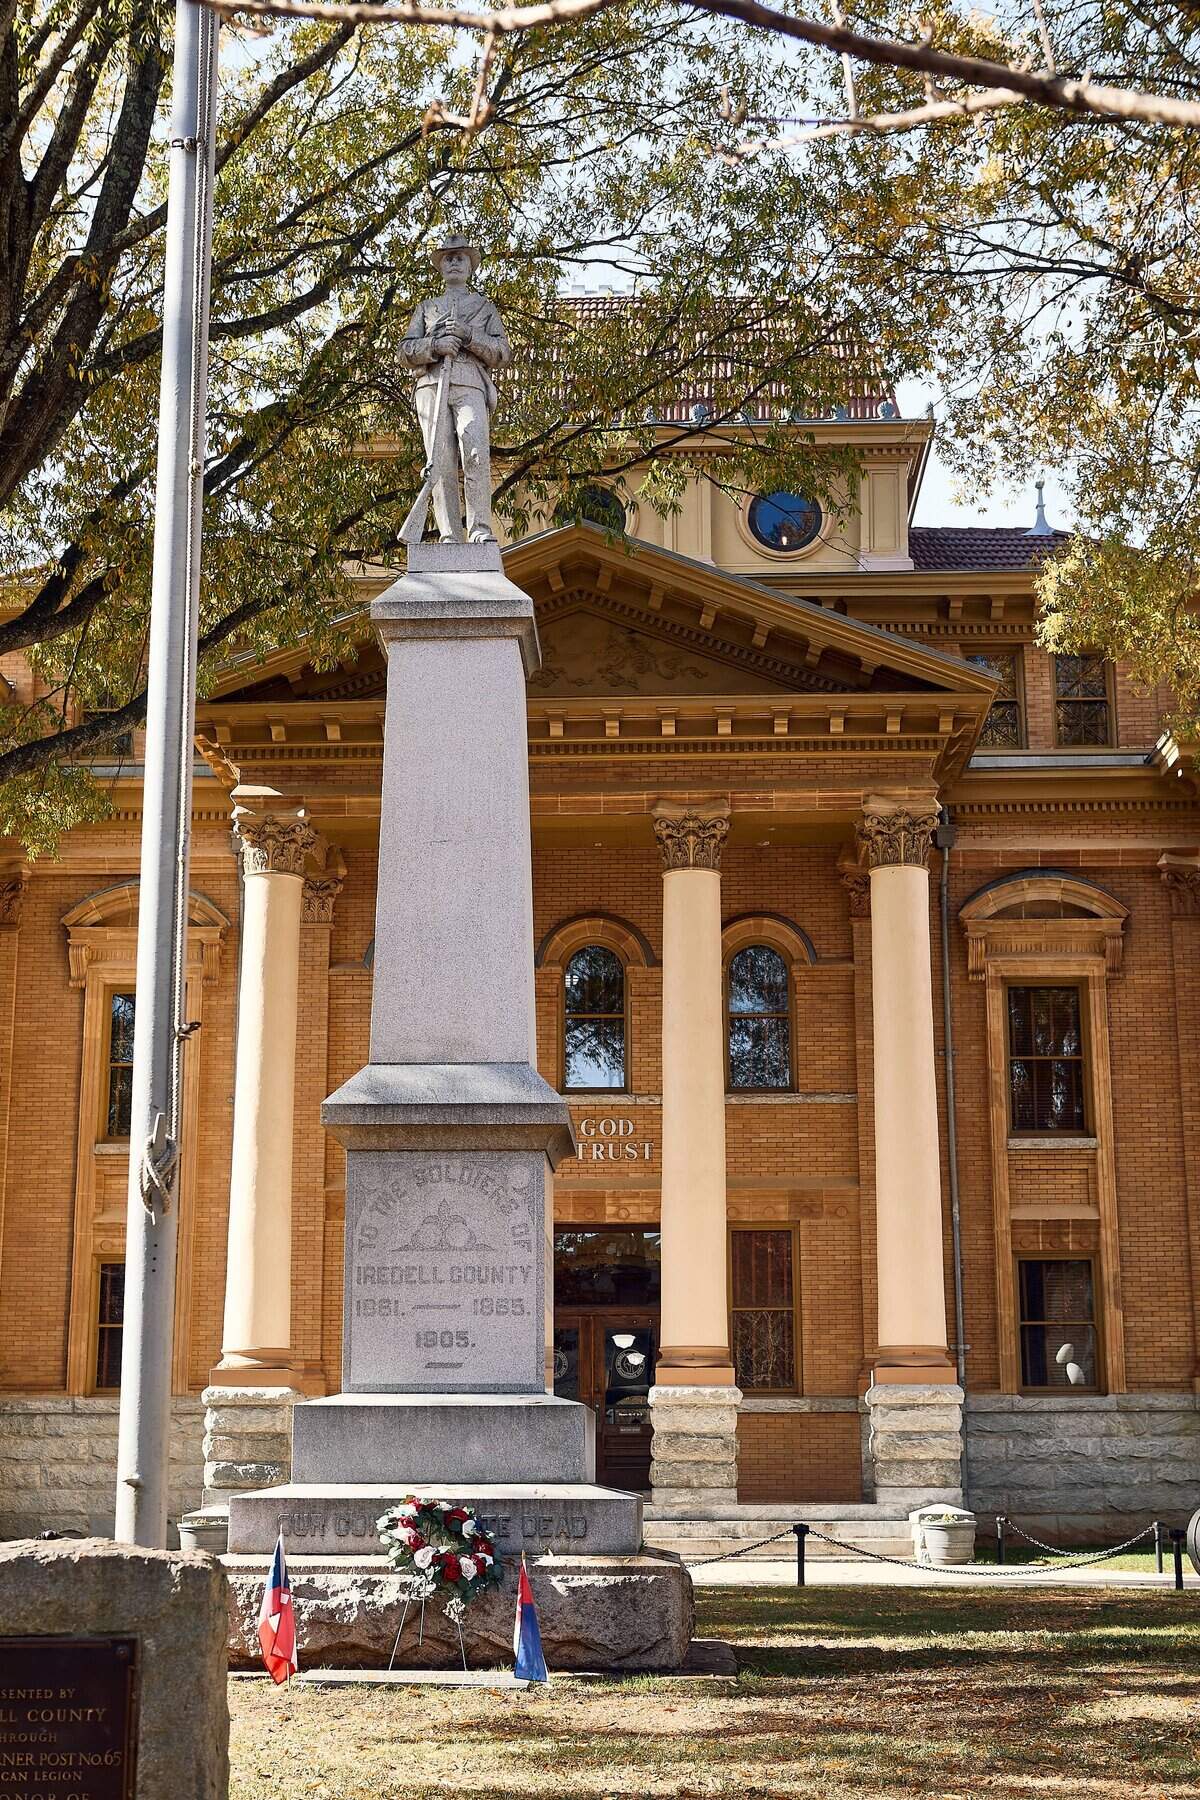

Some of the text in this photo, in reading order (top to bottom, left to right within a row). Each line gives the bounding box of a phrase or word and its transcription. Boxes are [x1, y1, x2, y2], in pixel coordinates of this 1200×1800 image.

[580, 1118, 634, 1137] GOD
[576, 1142, 654, 1161] TRUST
[358, 1164, 533, 1253] TO THE SOLDIERS OF
[356, 1264, 533, 1285] IREDELL COUNTY
[278, 1513, 325, 1537] OUR
[521, 1514, 587, 1538] DEAD
[1, 1688, 76, 1699] SENTED BY
[27, 1708, 107, 1722] COUNTY
[0, 1752, 34, 1766] NER
[40, 1752, 77, 1766] POST
[1, 1771, 83, 1781] CAN LEGION
